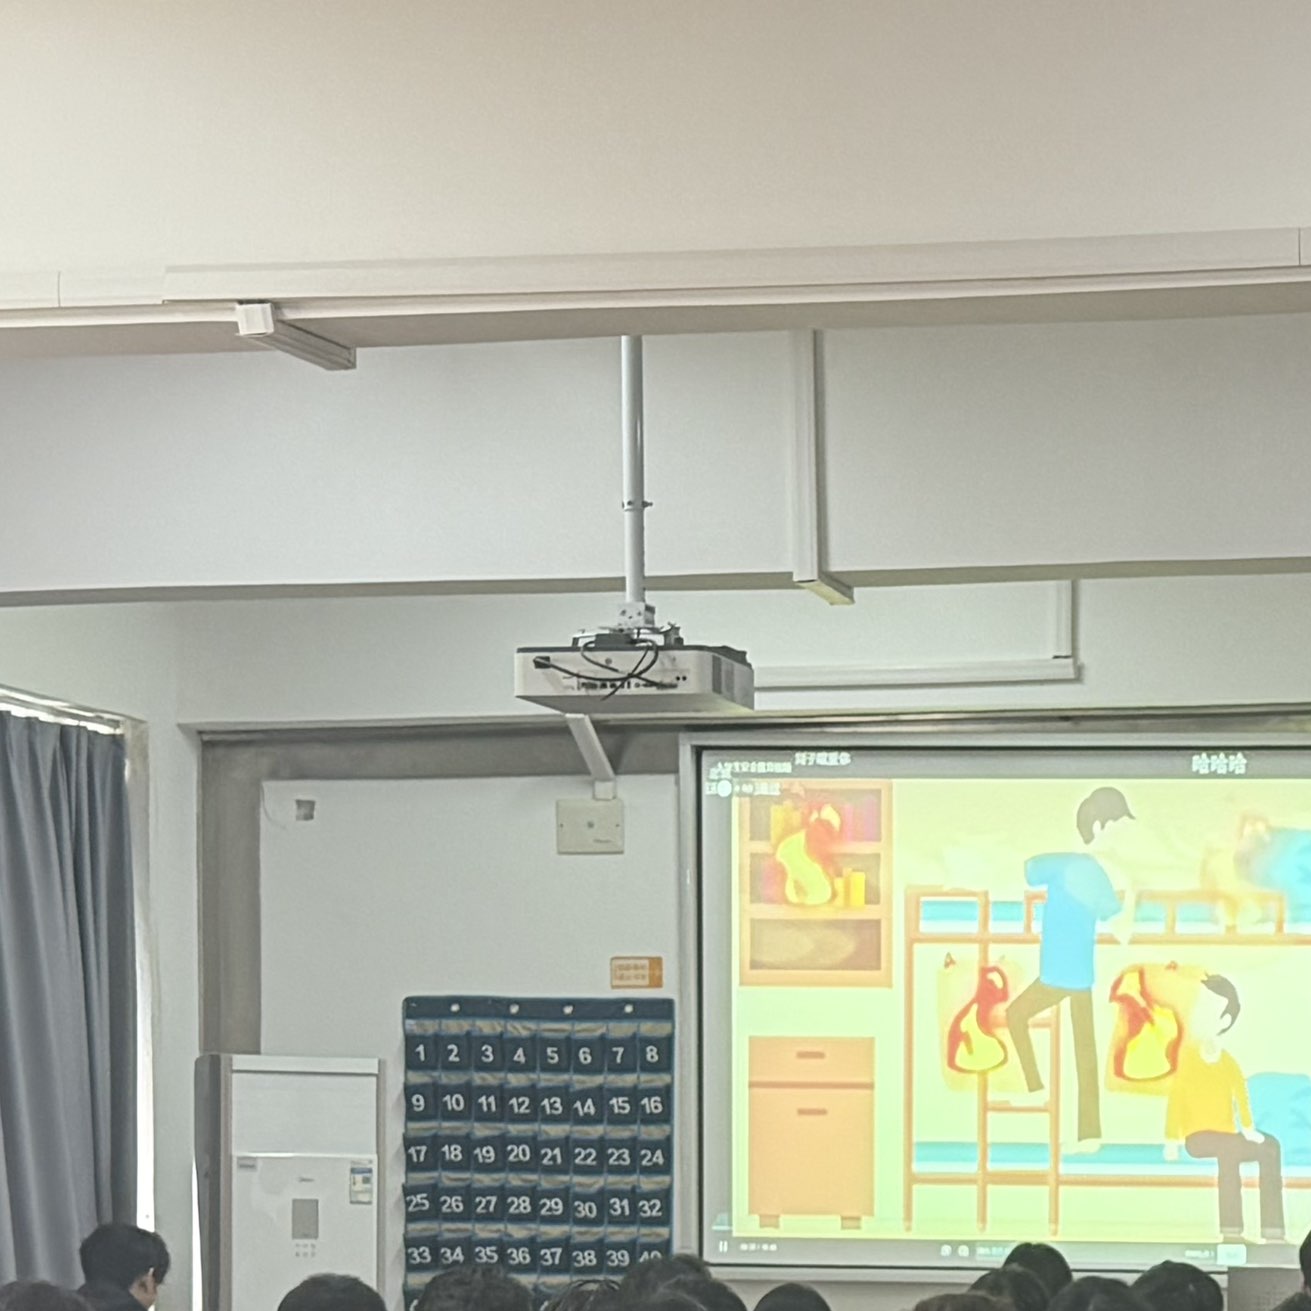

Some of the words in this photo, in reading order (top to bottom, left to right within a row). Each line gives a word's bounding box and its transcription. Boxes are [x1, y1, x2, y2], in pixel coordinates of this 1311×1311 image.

[415, 1044, 425, 1062] 1
[447, 1044, 460, 1062] 2
[481, 1044, 494, 1063] 3
[513, 1047, 526, 1064] 4
[546, 1046, 559, 1064] 5
[578, 1047, 592, 1065] 6
[612, 1046, 625, 1064] 7
[645, 1045, 659, 1063] 8
[411, 1094, 425, 1112] 9
[442, 1093, 465, 1111] 10
[478, 1095, 496, 1112] 11
[508, 1096, 531, 1114] 12
[540, 1096, 563, 1115] 13
[573, 1098, 596, 1117] 14
[609, 1096, 631, 1114] 15
[640, 1096, 663, 1114] 16
[407, 1145, 428, 1163] 17
[441, 1144, 463, 1162] 18
[473, 1145, 496, 1163] 19
[506, 1144, 531, 1162] 20
[540, 1147, 562, 1165] 21
[574, 1147, 597, 1165] 22
[607, 1148, 631, 1166] 23
[640, 1149, 665, 1166] 24
[406, 1193, 430, 1212] 25
[440, 1195, 464, 1213] 26
[475, 1195, 497, 1213] 27
[507, 1195, 532, 1214] 28
[539, 1197, 564, 1216] 29
[573, 1200, 597, 1218] 30
[609, 1197, 630, 1216] 31
[638, 1199, 662, 1217] 32
[407, 1246, 432, 1264] 33
[440, 1246, 465, 1264] 34
[474, 1246, 499, 1263] 35
[506, 1247, 531, 1265] 36
[540, 1247, 563, 1266] 37
[572, 1249, 597, 1267] 38
[606, 1249, 630, 1267] 39
